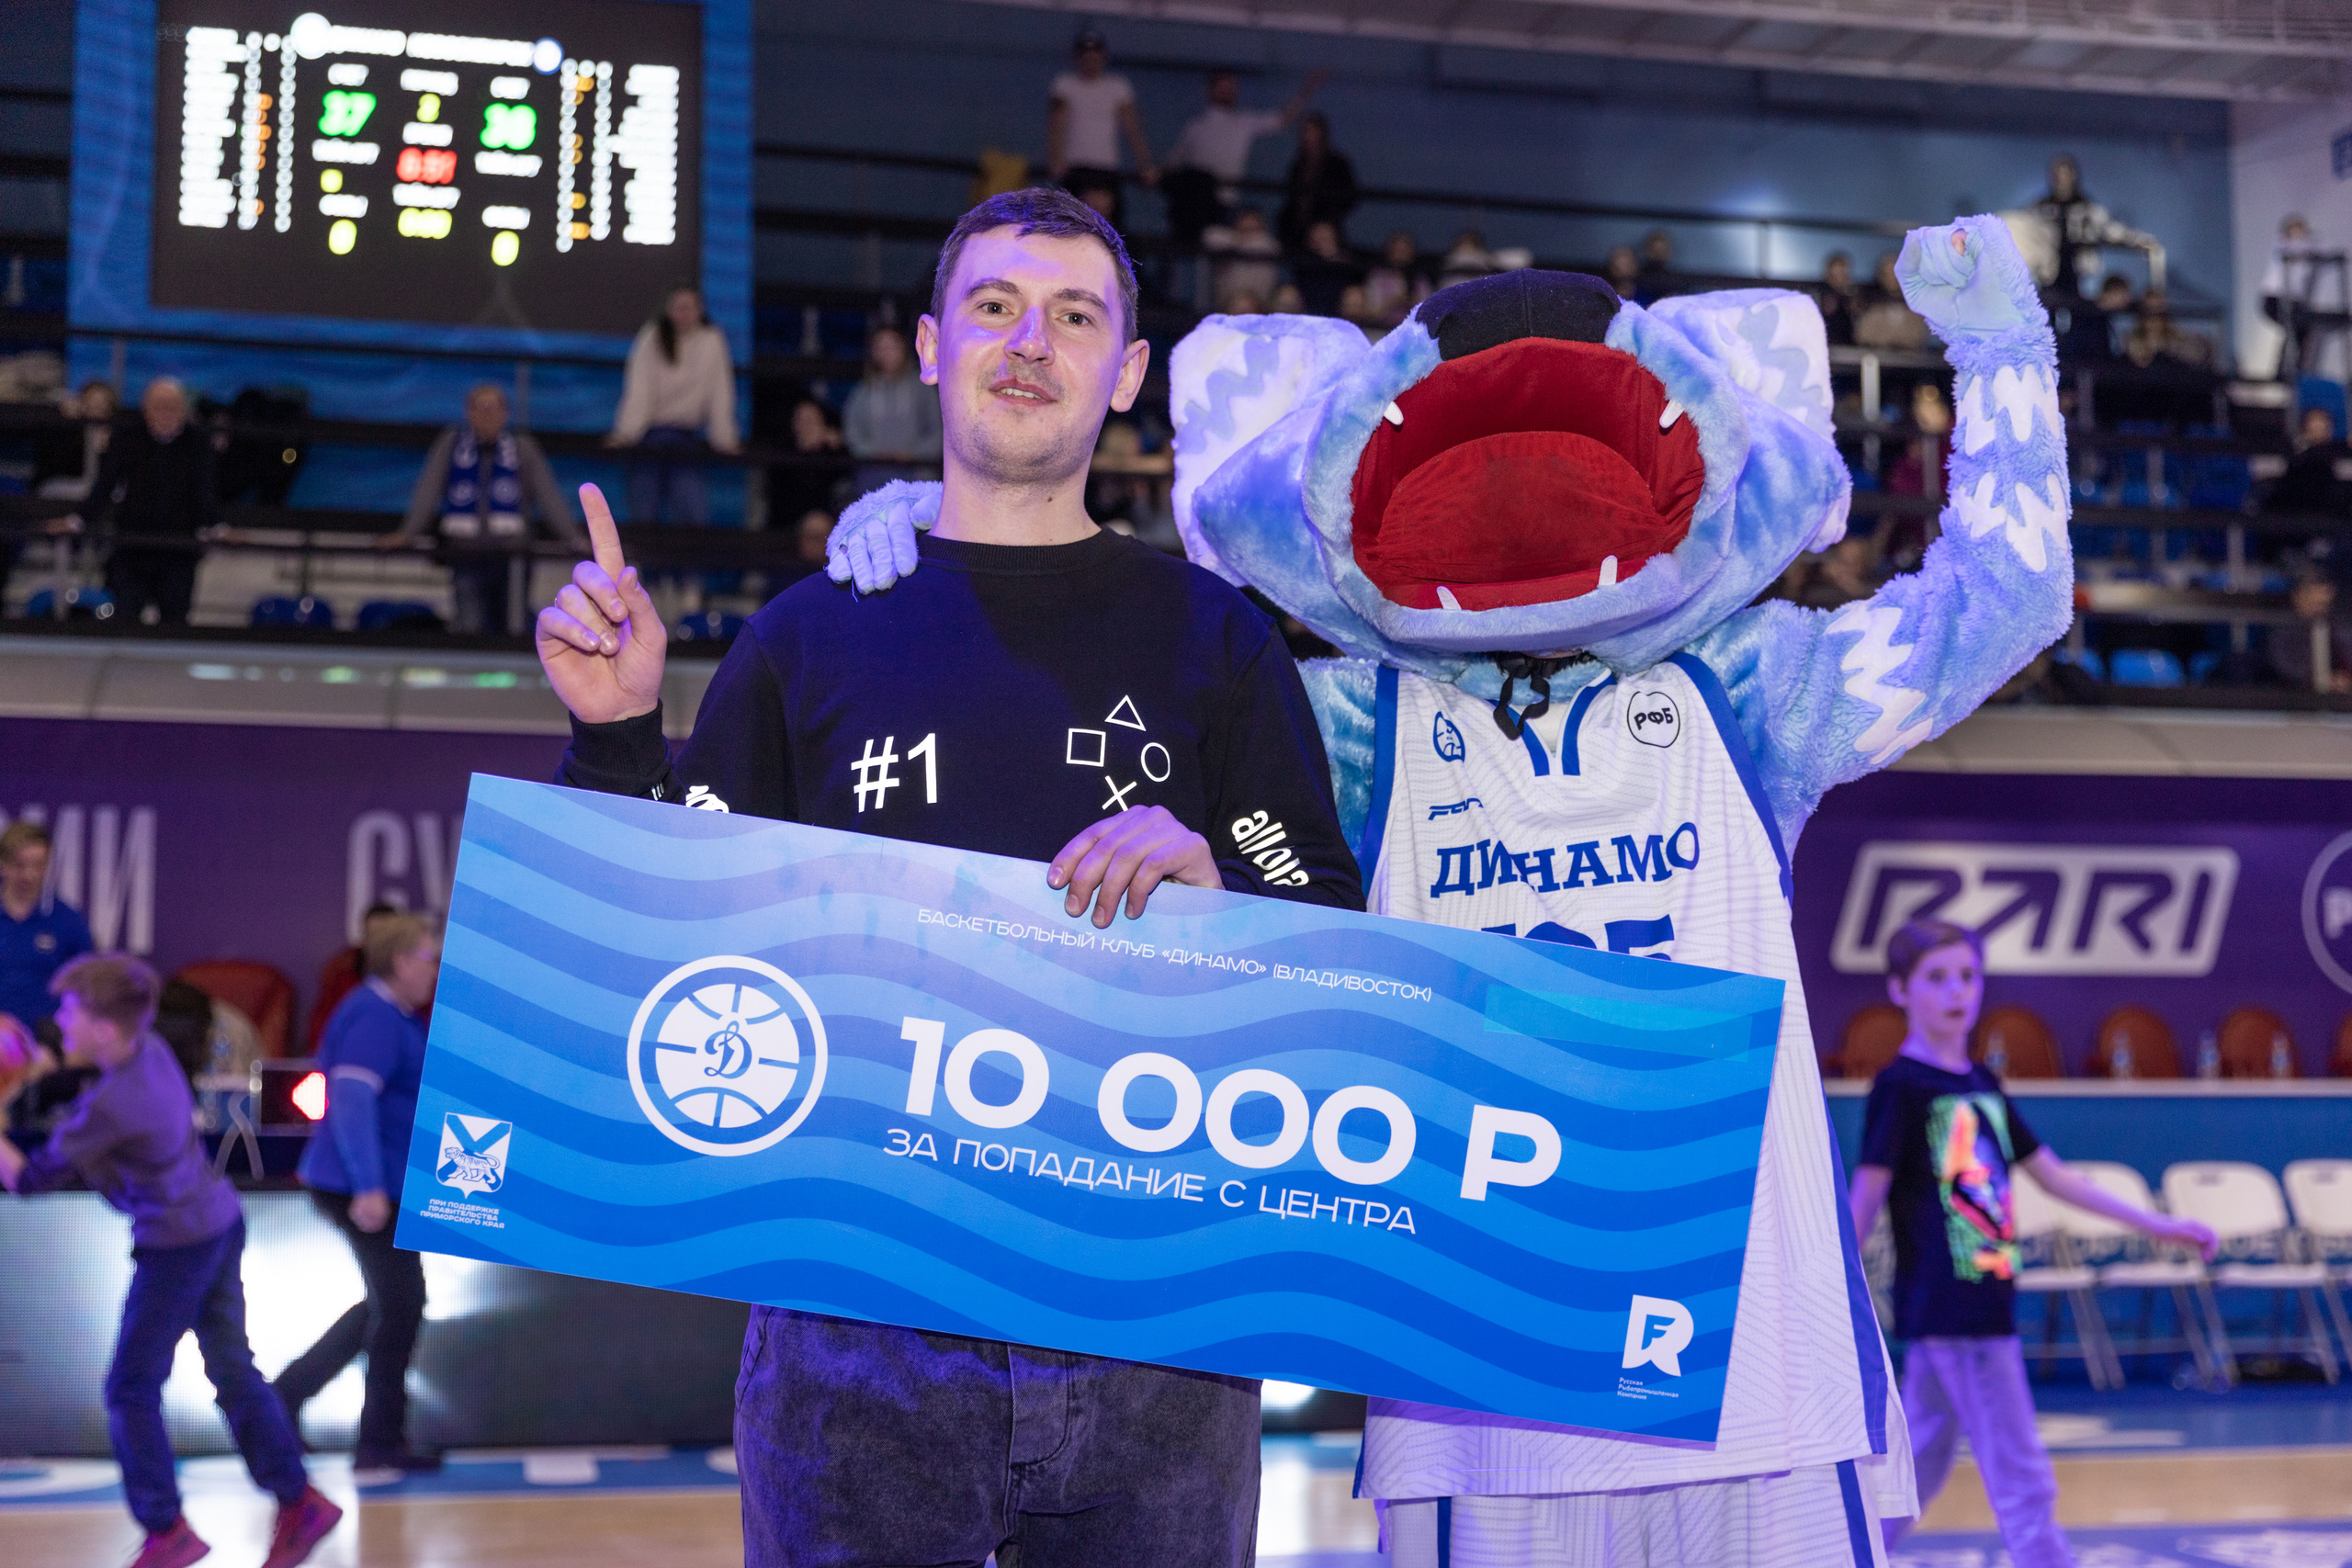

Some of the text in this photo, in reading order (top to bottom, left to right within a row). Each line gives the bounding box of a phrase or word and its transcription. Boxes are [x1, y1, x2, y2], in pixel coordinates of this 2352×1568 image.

[1634, 707, 1674, 730] РФБ
[851, 733, 937, 813] #1
[1430, 822, 1700, 898] ДИНАМО
[918, 908, 1432, 1003] БАСКЕТБОЛЬНЫЙ КЛУБ «ДИНАМО» (ВЛАДИВОСТОК)
[900, 1016, 1049, 1129] 10
[1097, 1052, 1417, 1186] 000
[883, 1128, 1416, 1235] ЗА ПОПАДАНИЕ С ЦЕНТРА
[428, 1205, 498, 1222] ПРАВИТЕЛЬСТВА
[429, 1199, 500, 1215] ПРИ ПОДДЕРЖКЕ
[420, 1210, 505, 1229] ПРИМОРСКОГО КРАЯ
[1619, 1377, 1644, 1386] Русская
[1617, 1390, 1647, 1400] Компания
